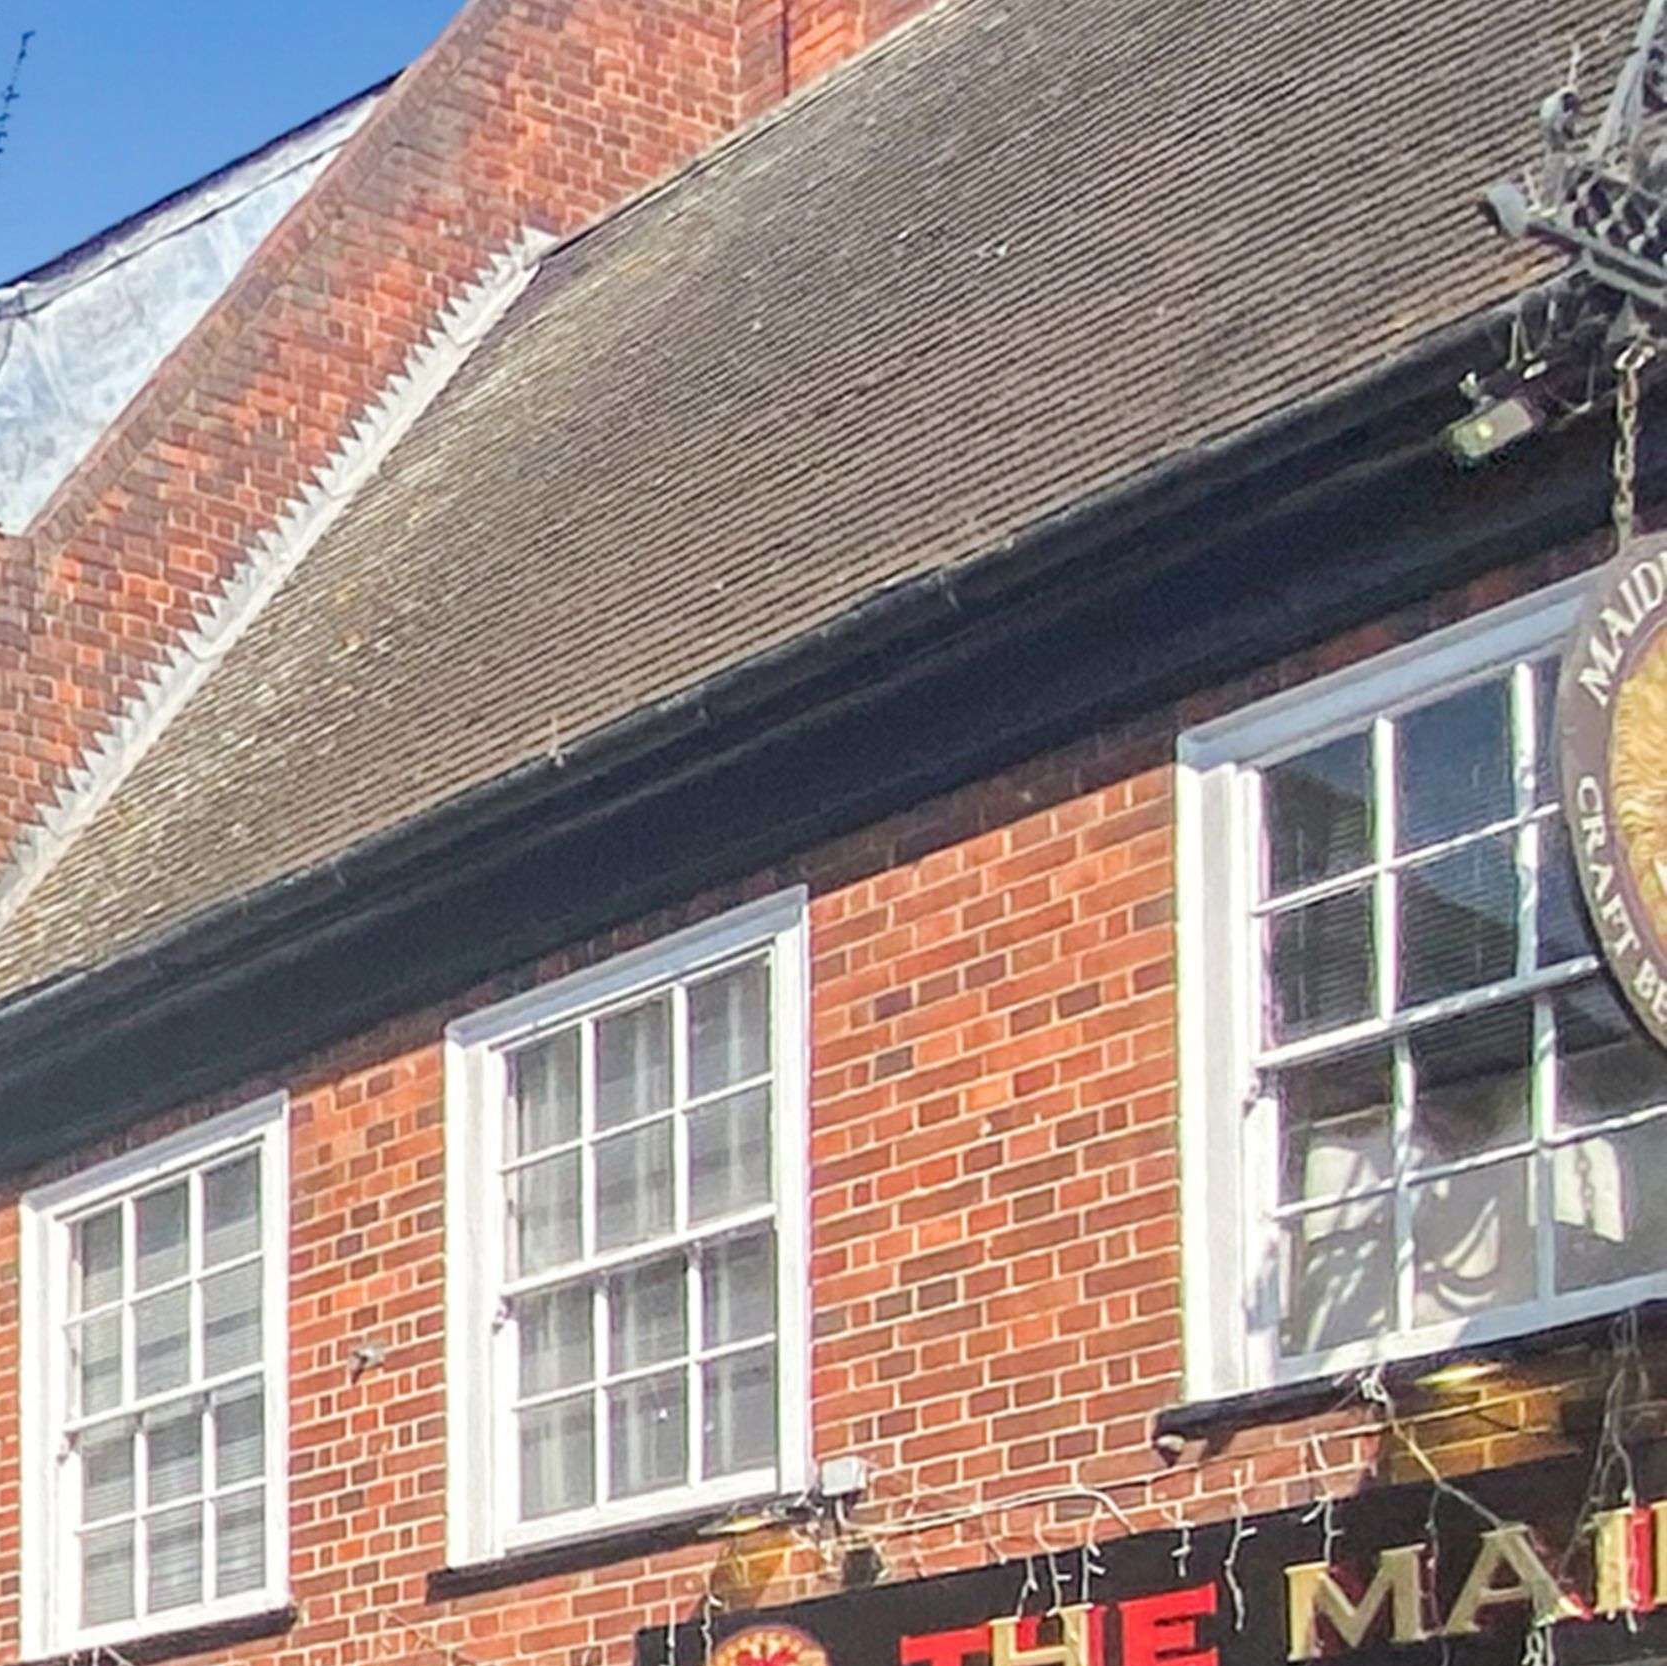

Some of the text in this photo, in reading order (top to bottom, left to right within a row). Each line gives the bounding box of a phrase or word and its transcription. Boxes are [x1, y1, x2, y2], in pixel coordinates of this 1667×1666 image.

[1579, 550, 1667, 708] MAID
[1577, 774, 1641, 958] CRAFT
[1284, 1502, 1667, 1664] MAI
